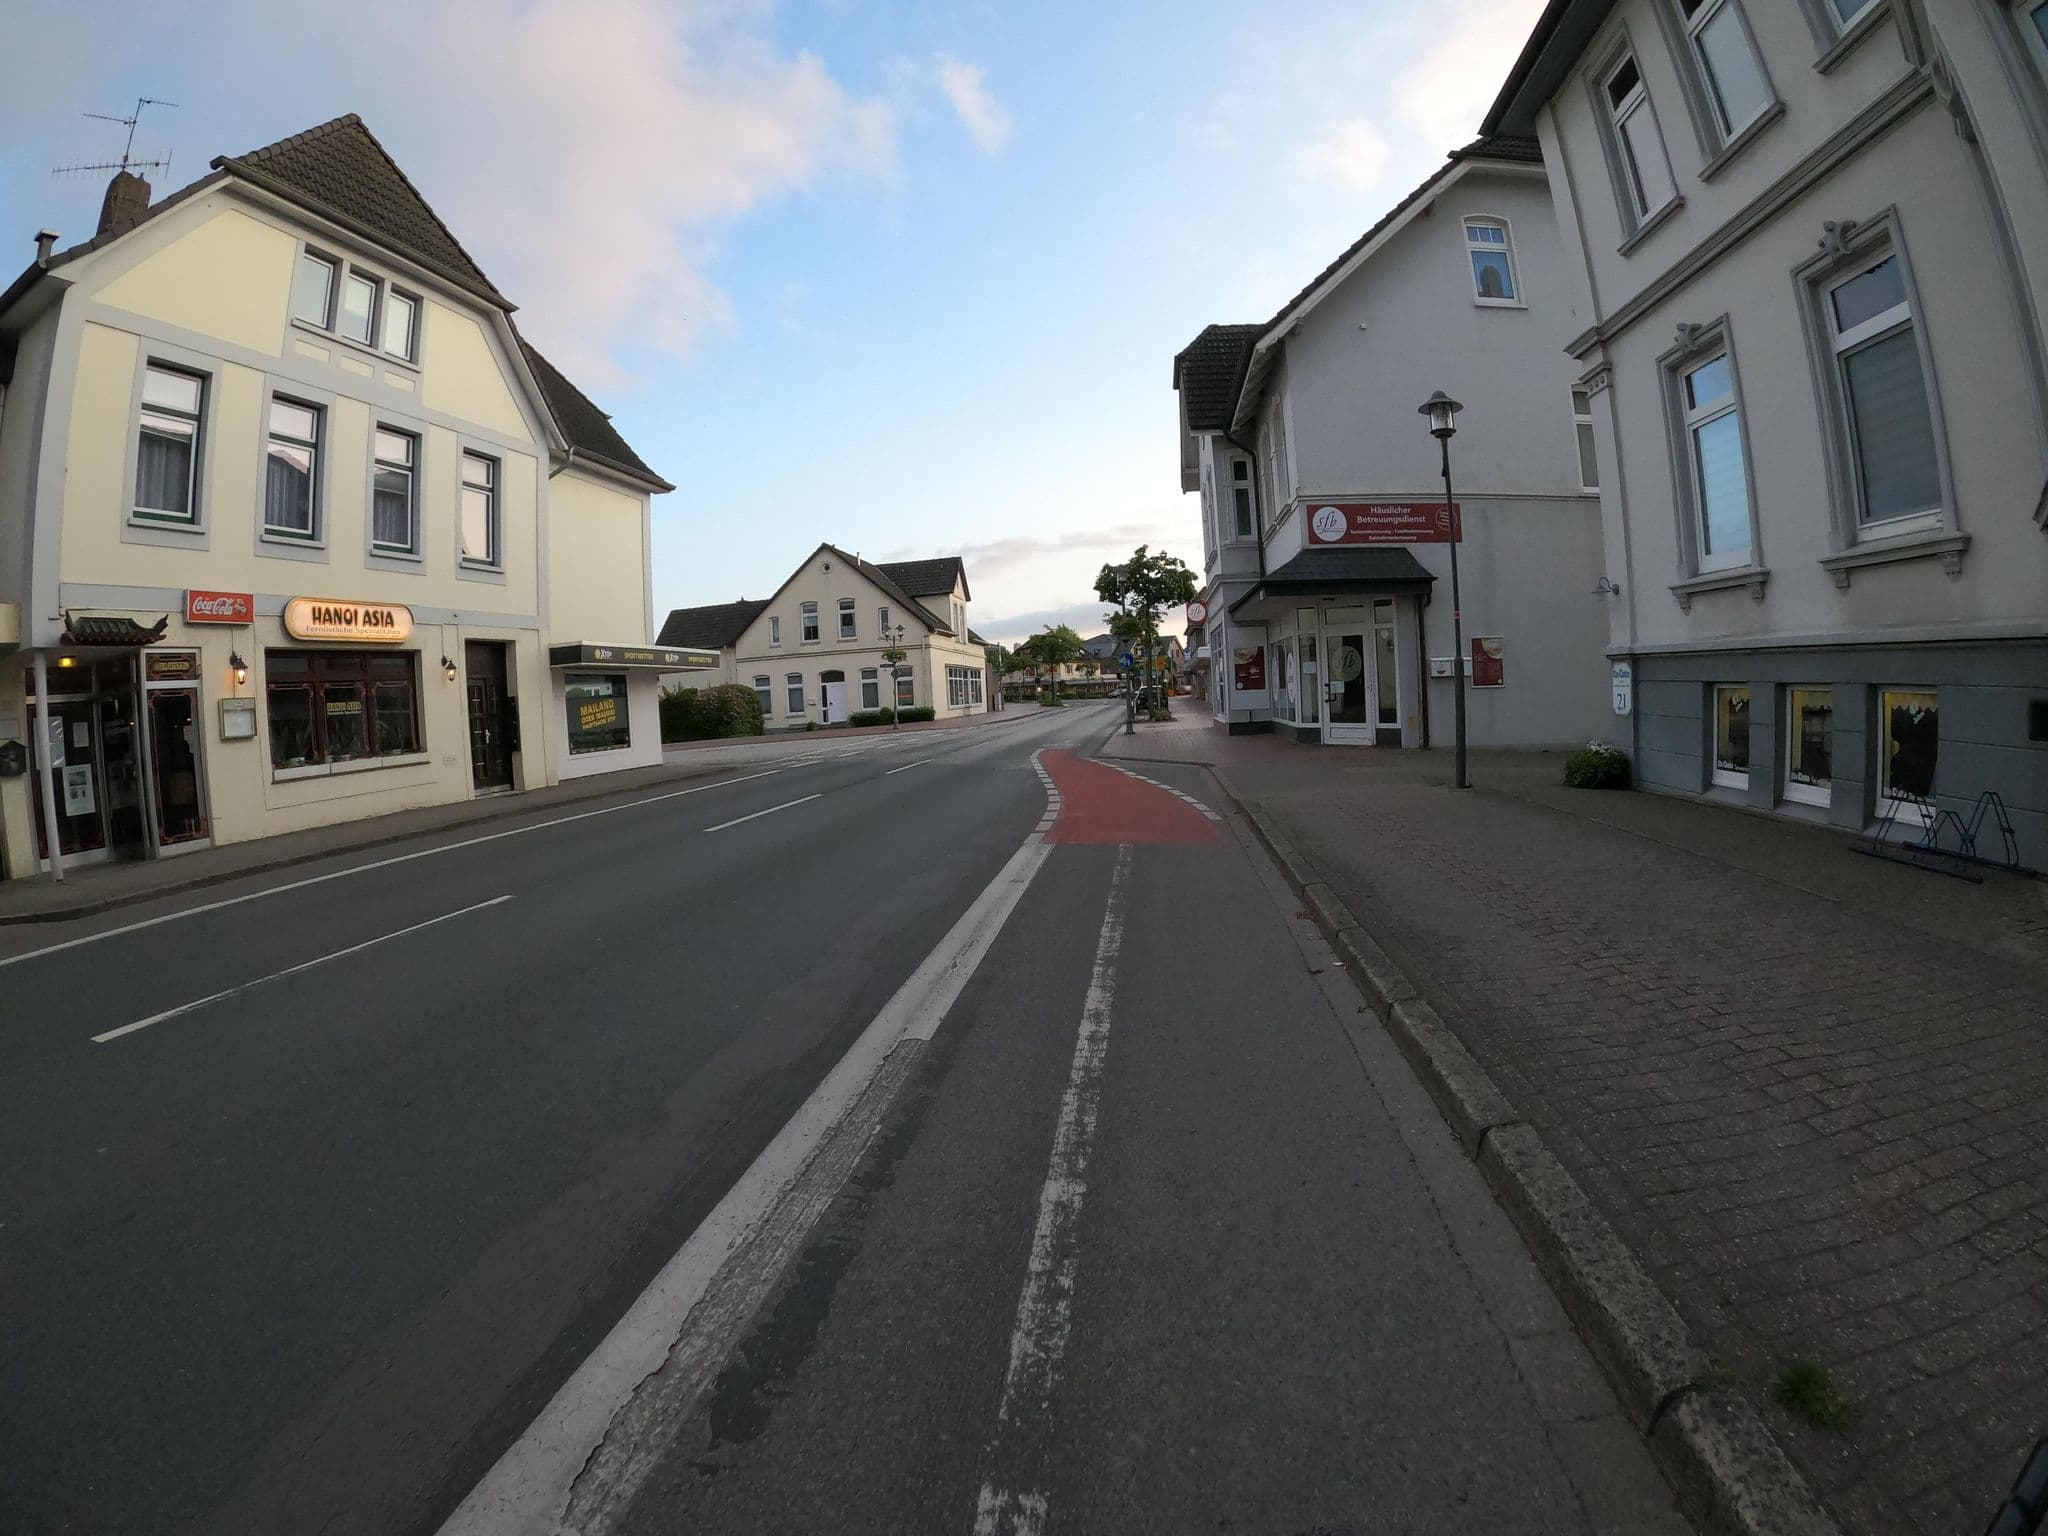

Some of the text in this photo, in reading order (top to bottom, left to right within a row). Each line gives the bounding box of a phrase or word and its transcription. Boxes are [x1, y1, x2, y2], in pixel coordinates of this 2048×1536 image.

[1370, 506, 1411, 514] Häuslicher
[1316, 511, 1338, 535] sfb
[1357, 515, 1426, 525] Betreuungsdienst
[192, 596, 234, 616] Coca-Cola
[311, 606, 395, 628] HANOI ASIA
[306, 625, 401, 636] Fernöstliche Spezialitäten
[580, 698, 614, 716] MAILAND
[1616, 693, 1626, 710] 21
